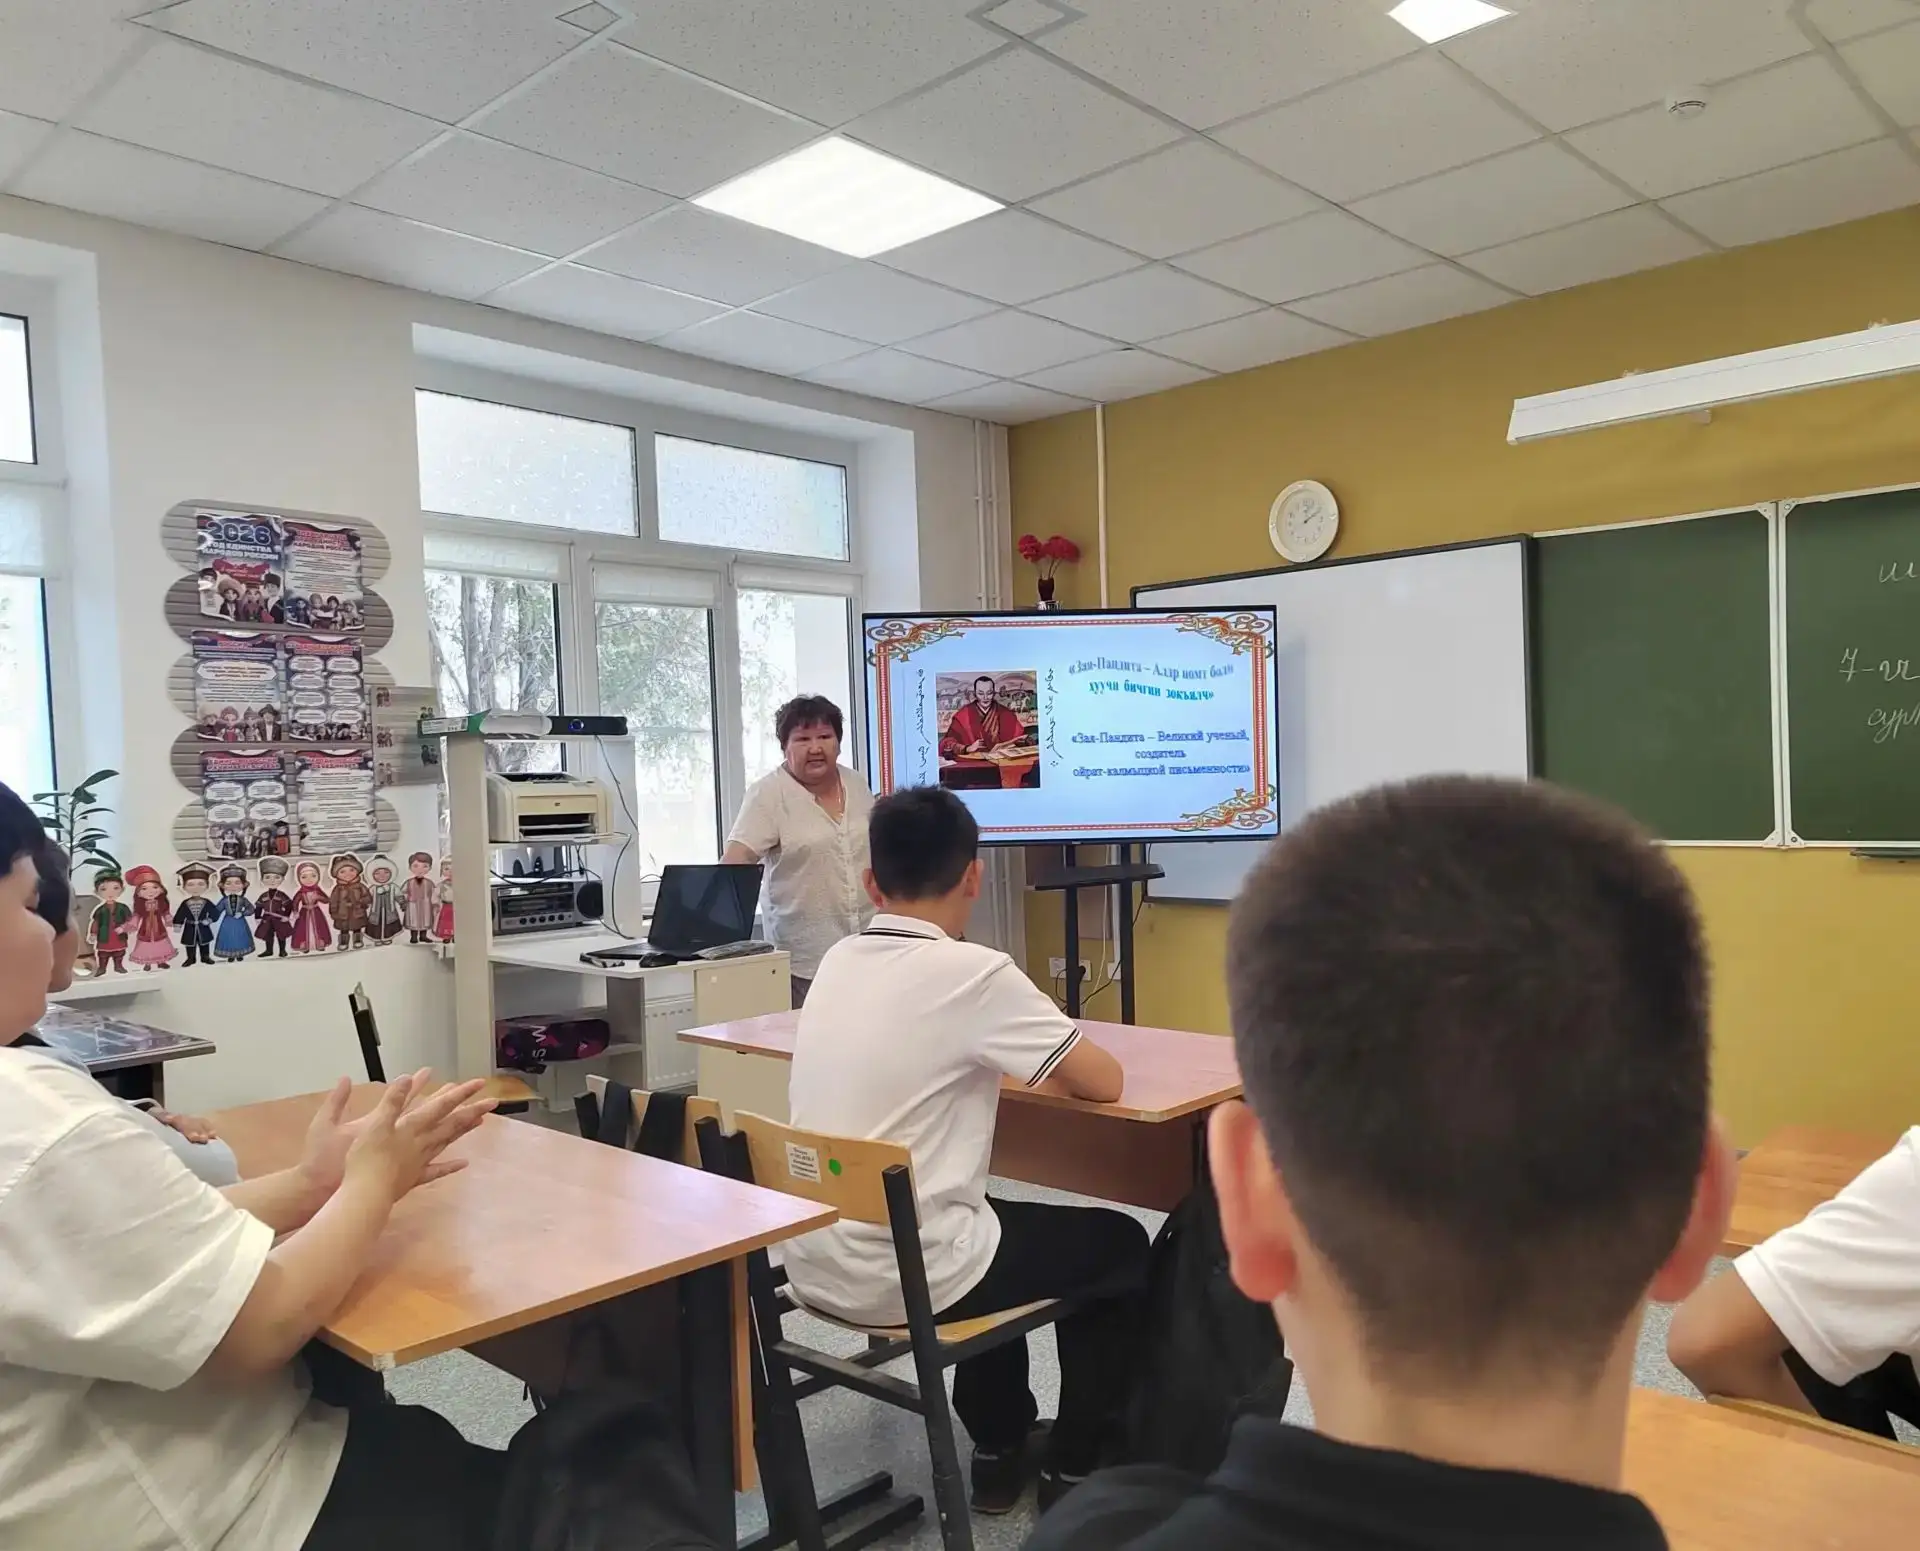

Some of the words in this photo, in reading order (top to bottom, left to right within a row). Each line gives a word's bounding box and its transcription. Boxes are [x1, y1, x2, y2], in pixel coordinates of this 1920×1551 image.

[206, 521, 271, 545] 2026
[1157, 731, 1204, 742] Великий
[1135, 749, 1187, 759] создатель
